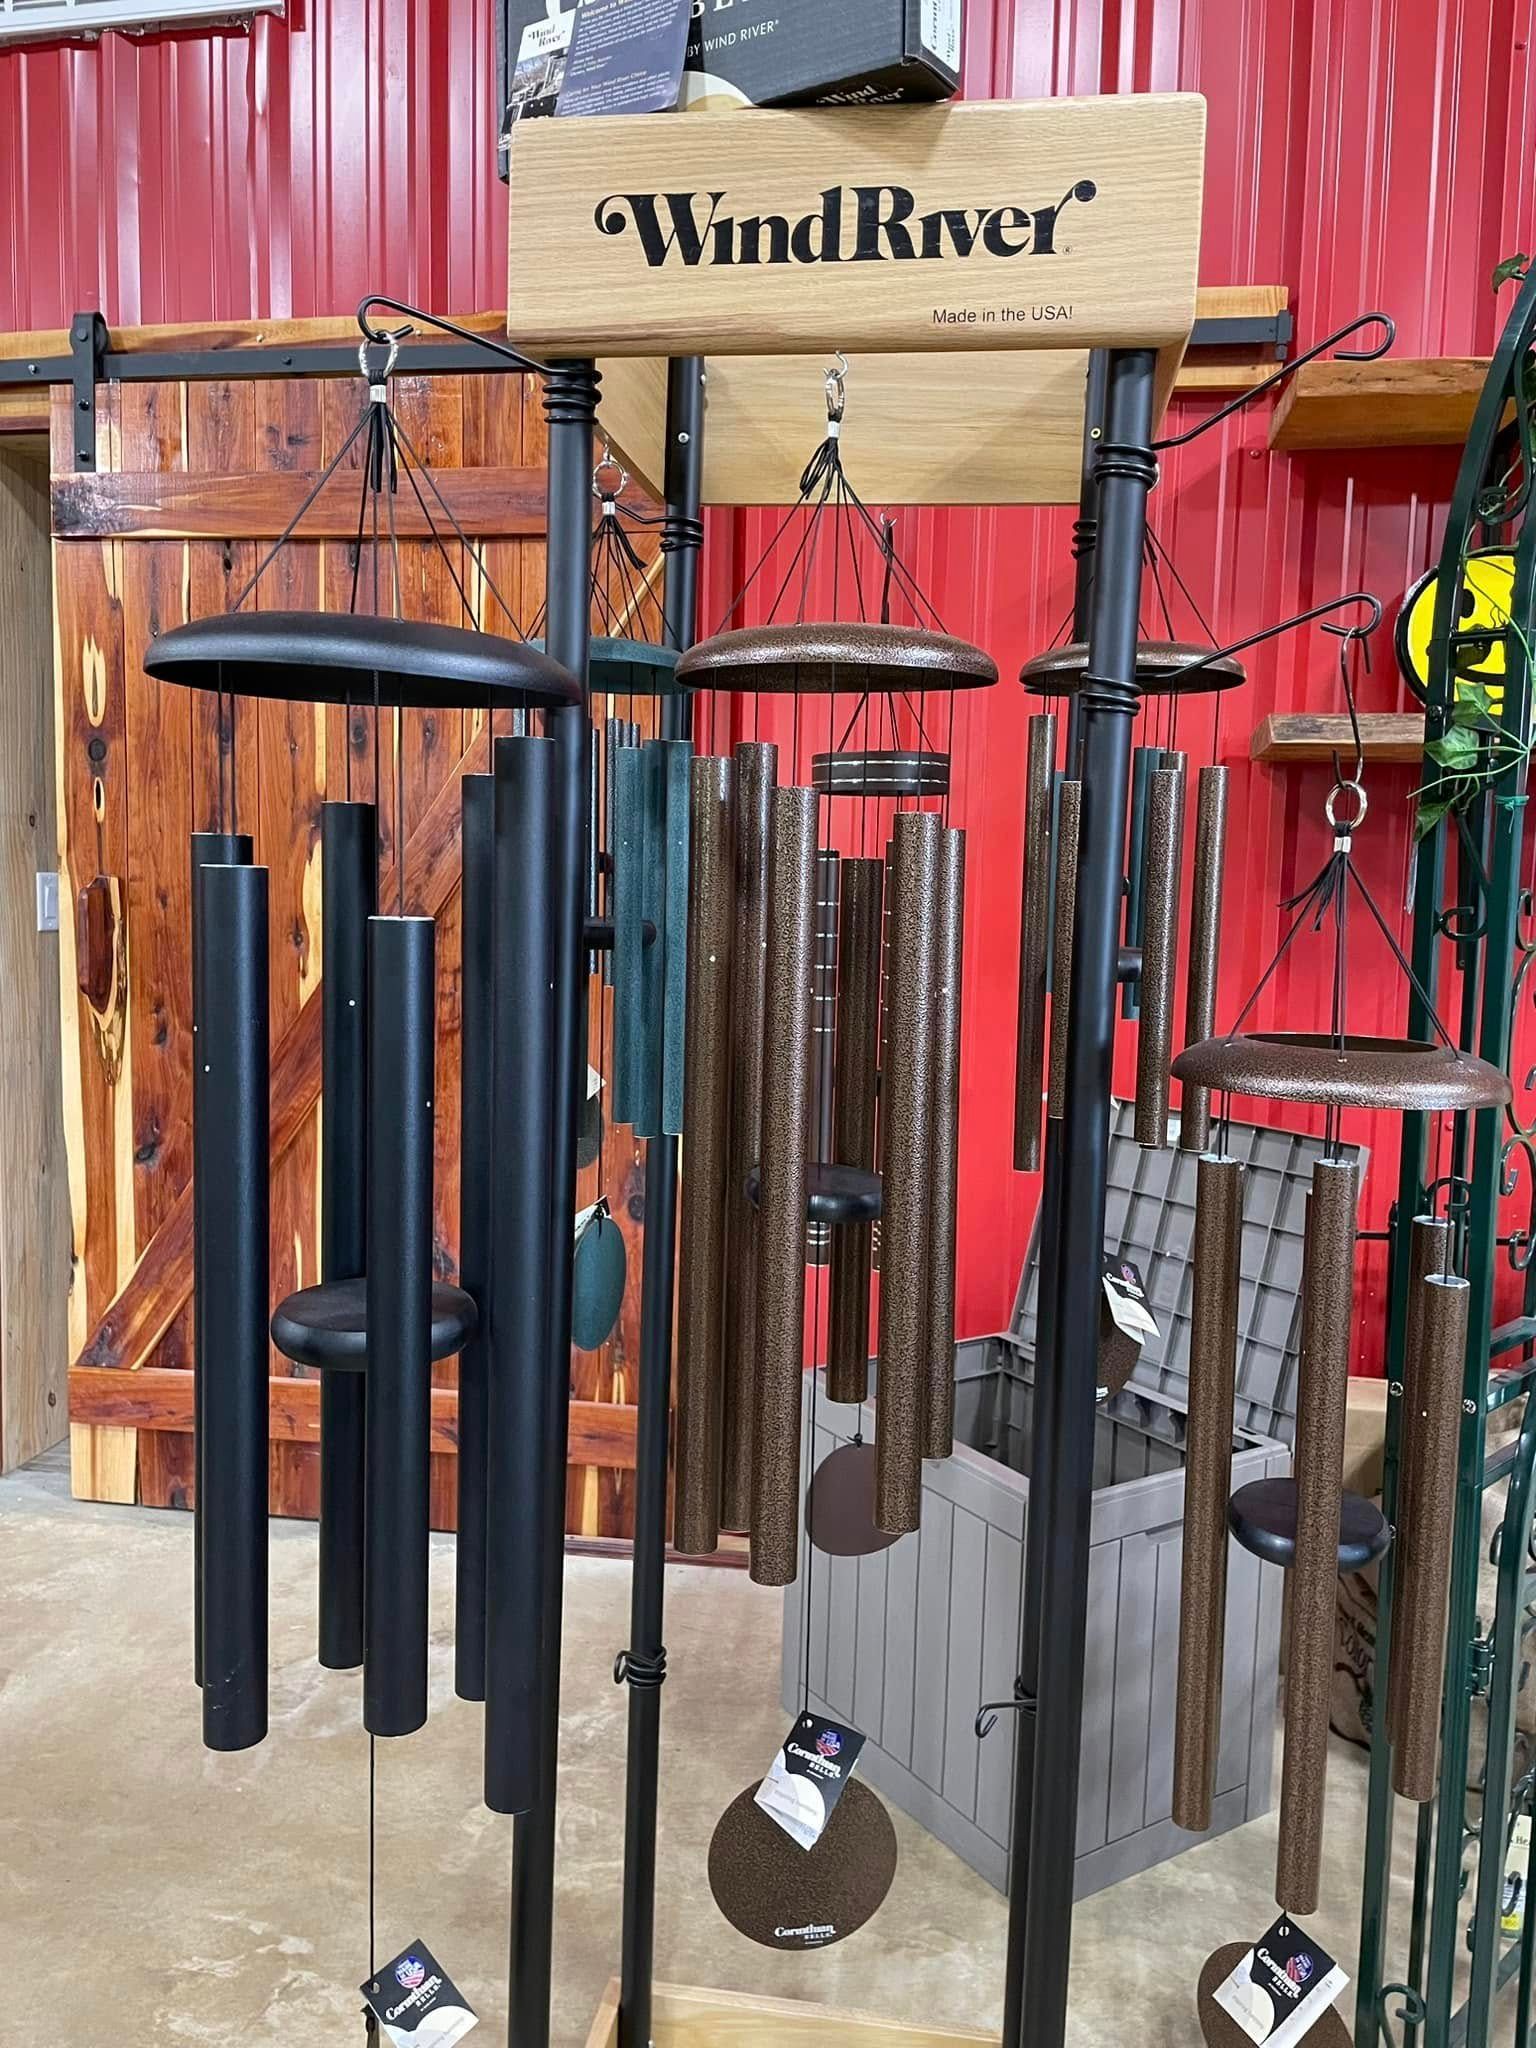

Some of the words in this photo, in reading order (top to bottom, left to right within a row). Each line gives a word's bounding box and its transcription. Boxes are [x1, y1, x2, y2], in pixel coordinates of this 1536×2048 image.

[704, 32, 736, 52] WIND
[932, 309, 976, 324] Made
[982, 308, 995, 322] in
[1001, 307, 1026, 322] the
[1032, 306, 1073, 320] USA!
